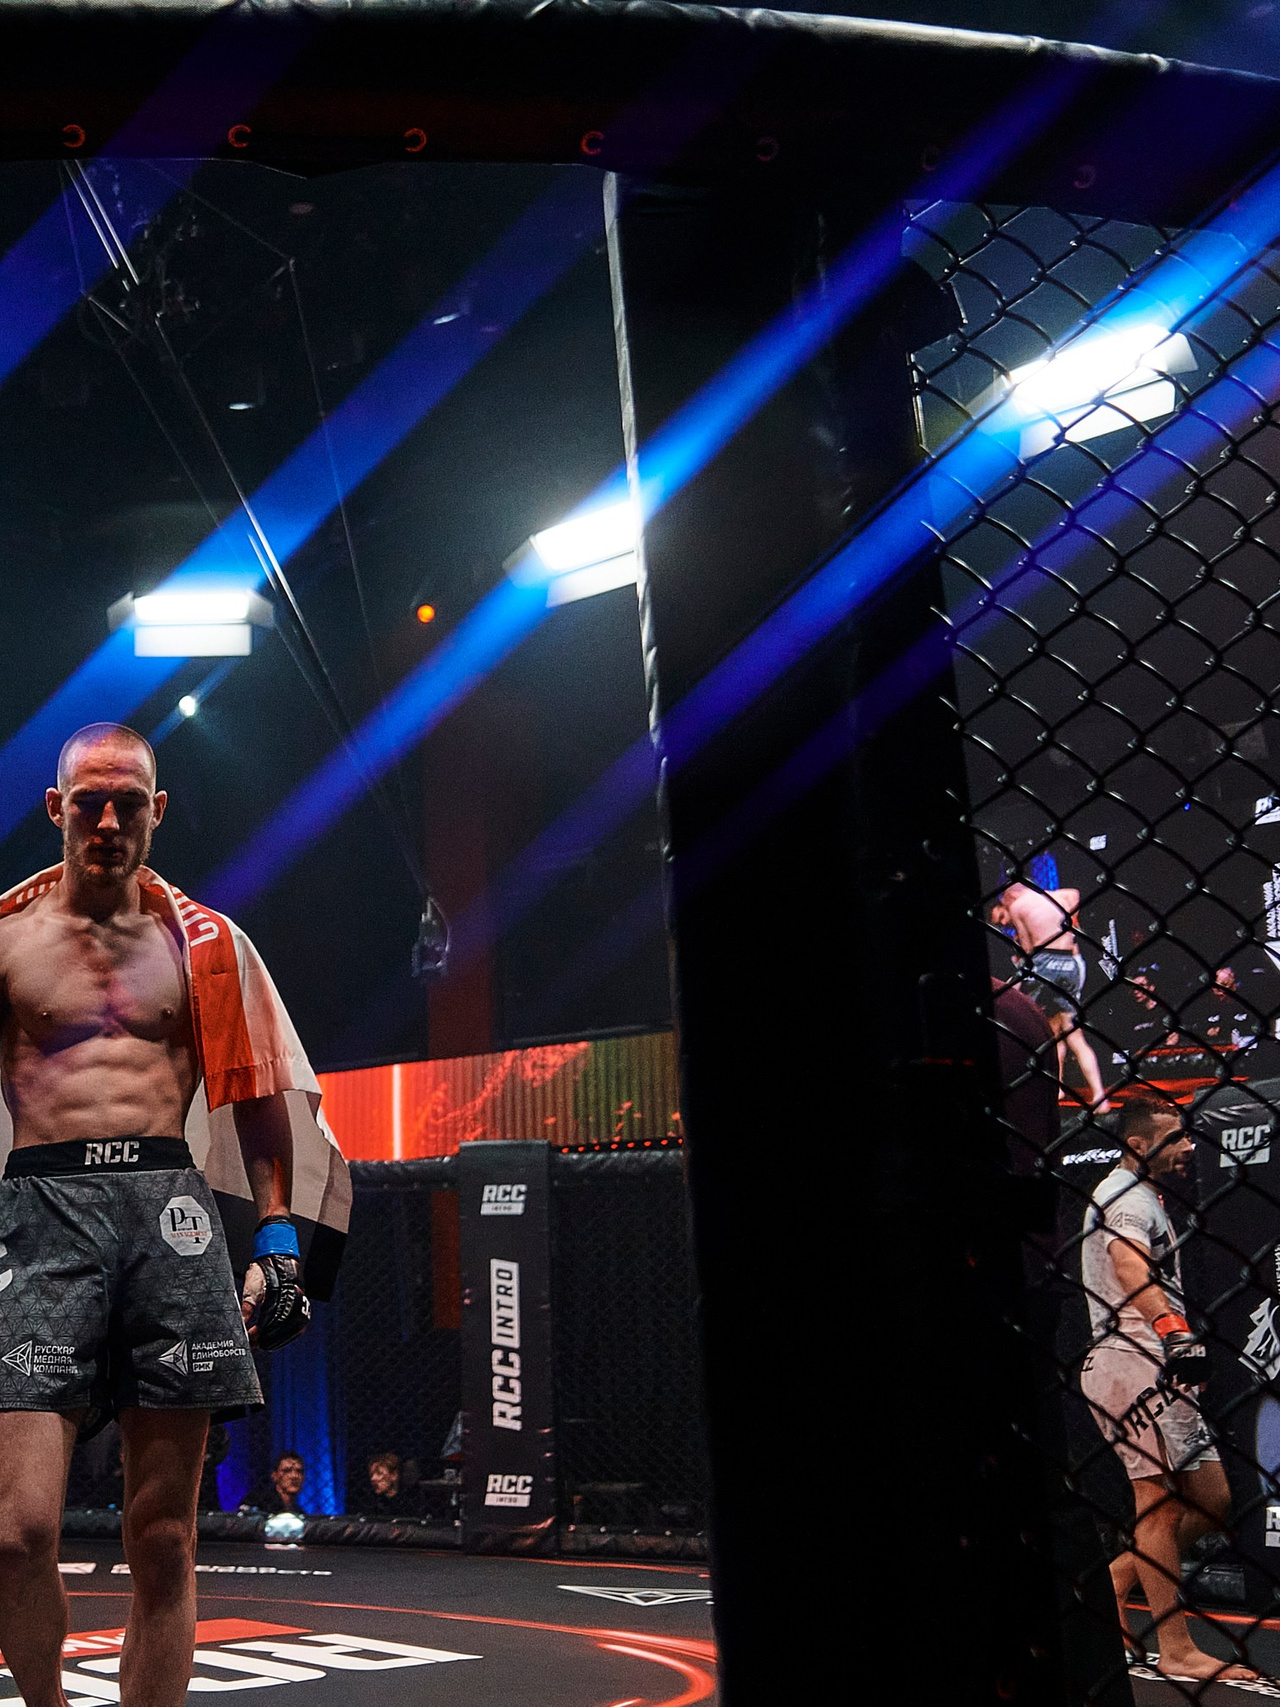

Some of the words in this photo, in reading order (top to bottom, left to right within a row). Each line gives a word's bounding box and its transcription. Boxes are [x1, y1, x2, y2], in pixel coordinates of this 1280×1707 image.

[84, 1141, 140, 1166] RCC
[482, 1184, 527, 1202] RCC
[496, 1268, 514, 1339] INTRO
[191, 1340, 234, 1350] АКАДЕМИЯ
[192, 1348, 246, 1360] ЕДИНОБОРСТВ
[33, 1354, 73, 1364] МЕДНАЯ
[491, 1349, 523, 1432] RCC
[486, 1474, 533, 1493] RCC
